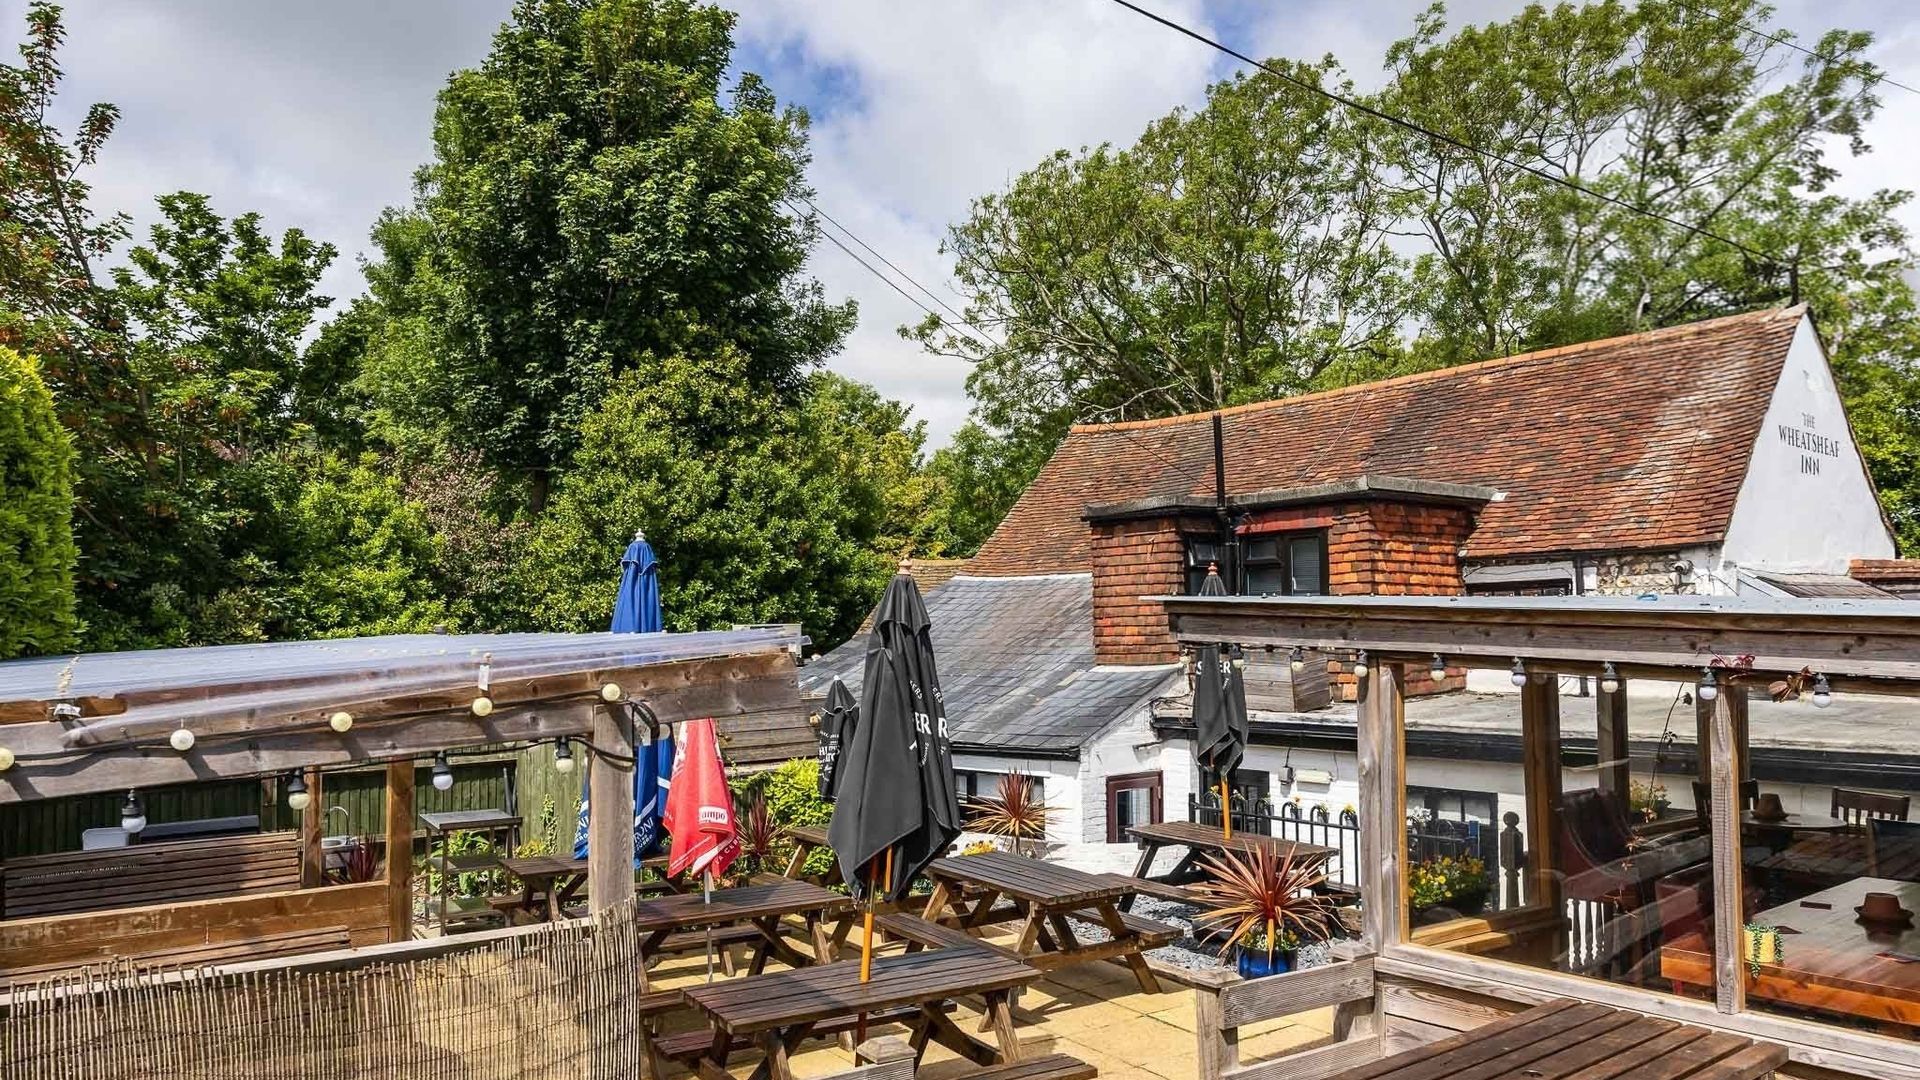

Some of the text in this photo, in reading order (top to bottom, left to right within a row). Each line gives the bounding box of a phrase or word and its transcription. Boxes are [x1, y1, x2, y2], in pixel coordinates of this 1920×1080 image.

[1801, 412, 1816, 430] THE
[1778, 424, 1840, 458] WHEATSHEAF
[1801, 454, 1820, 476] INN
